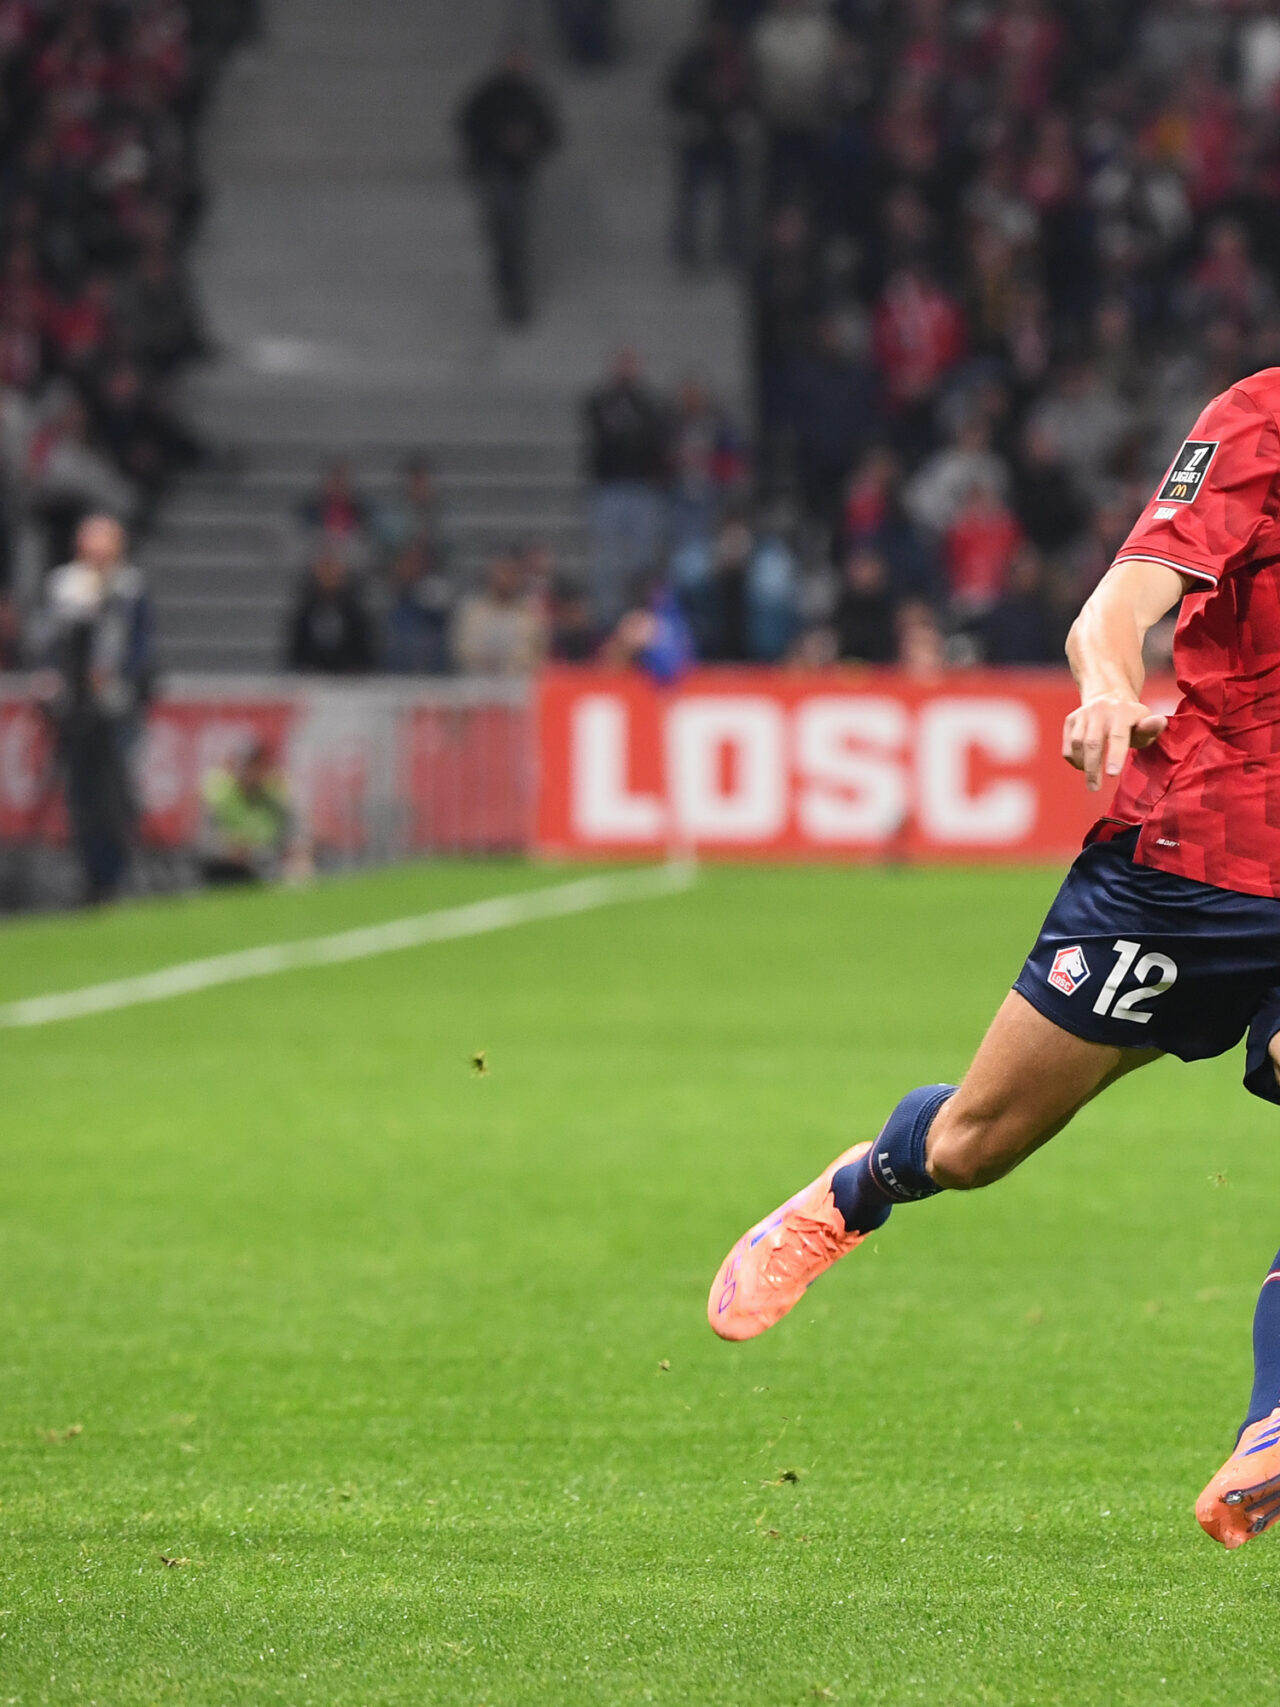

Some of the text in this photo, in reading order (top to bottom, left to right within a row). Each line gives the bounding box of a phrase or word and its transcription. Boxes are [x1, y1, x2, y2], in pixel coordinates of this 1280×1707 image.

[571, 697, 1036, 841] LOSC
[1052, 974, 1071, 990] LOSC
[1092, 939, 1178, 1024] 12
[878, 1152, 926, 1198] LOS
